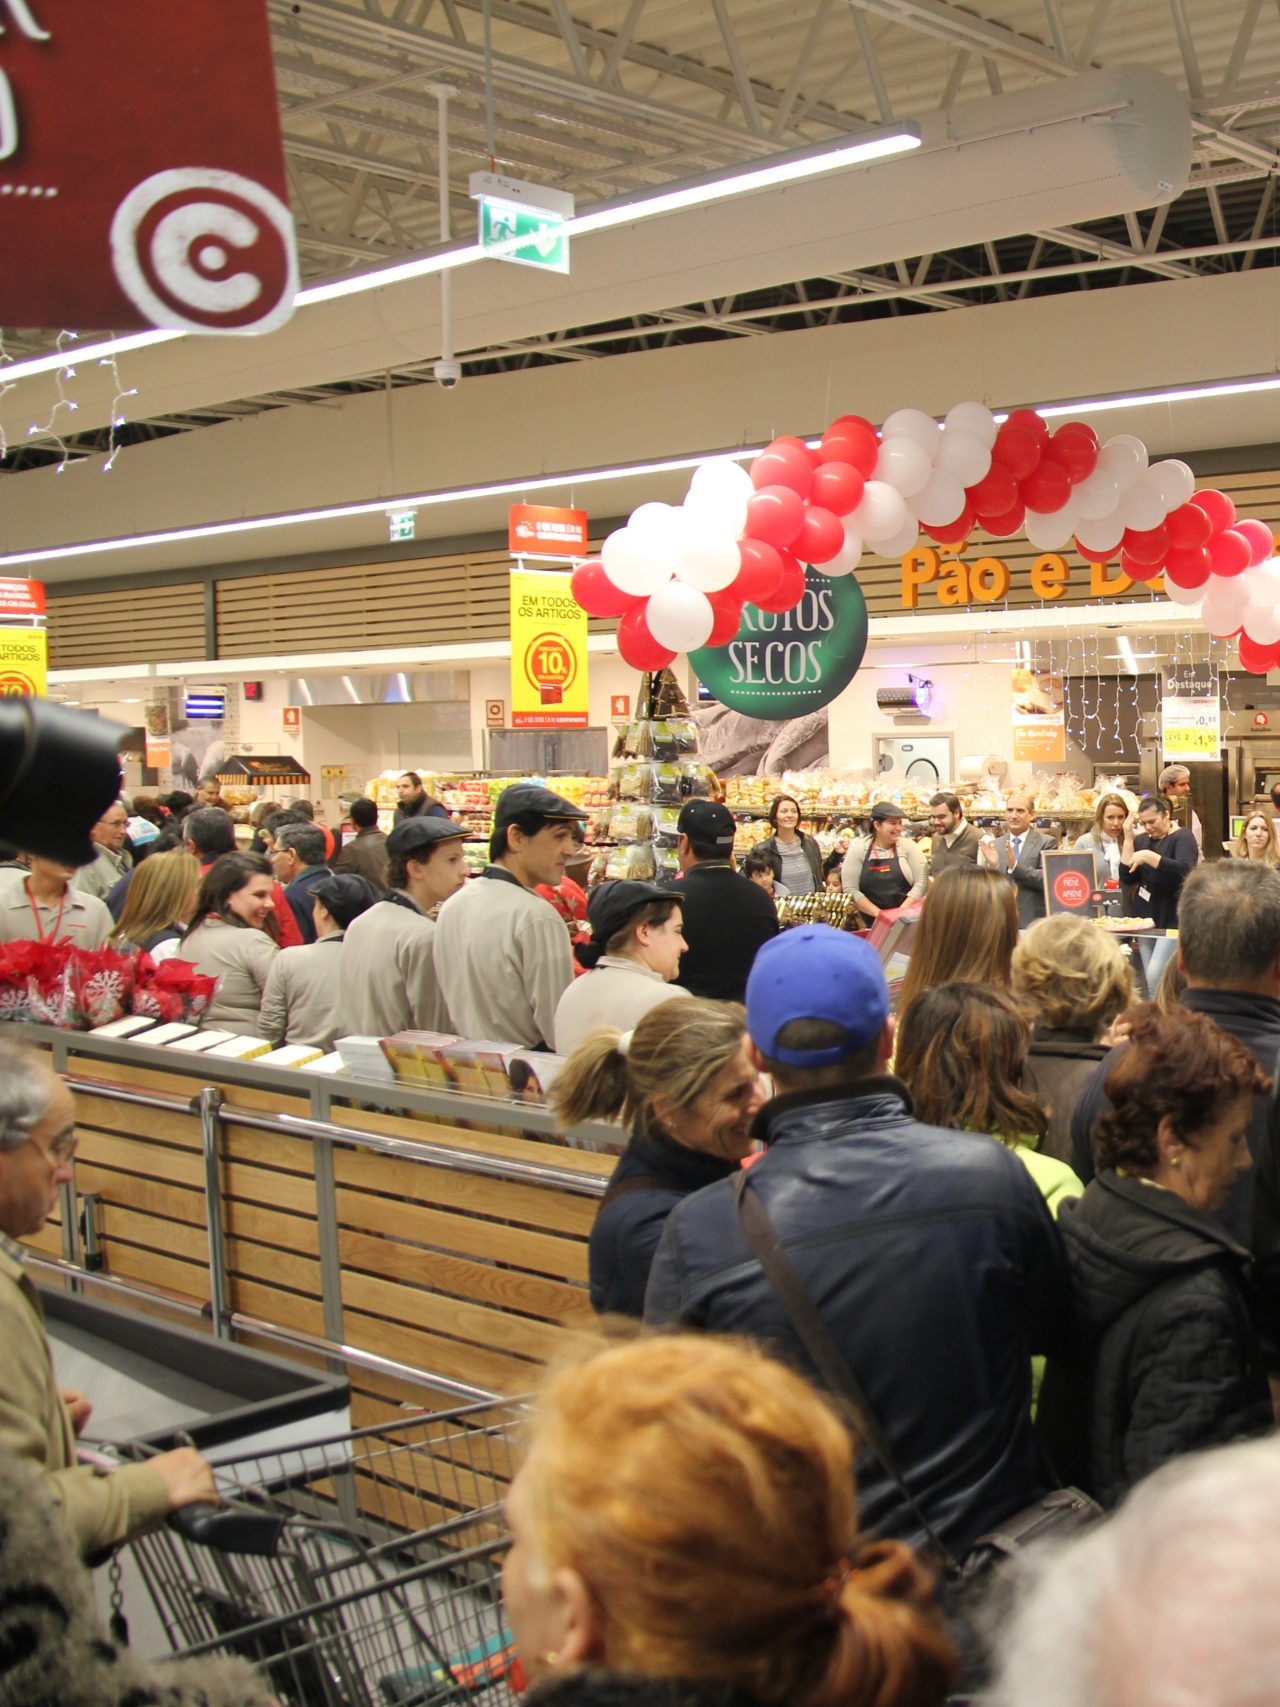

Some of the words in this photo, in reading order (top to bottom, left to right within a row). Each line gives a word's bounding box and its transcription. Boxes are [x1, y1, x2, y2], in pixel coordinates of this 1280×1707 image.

[902, 541, 1011, 607] Pão
[1030, 552, 1070, 599] e
[522, 595, 538, 606] EM
[541, 597, 577, 609] TODOS
[518, 606, 533, 617] OS
[536, 608, 582, 620] ARTIGOS
[728, 640, 823, 684] SECOS
[1183, 670, 1195, 679] Em
[1167, 680, 1212, 690] Destaque
